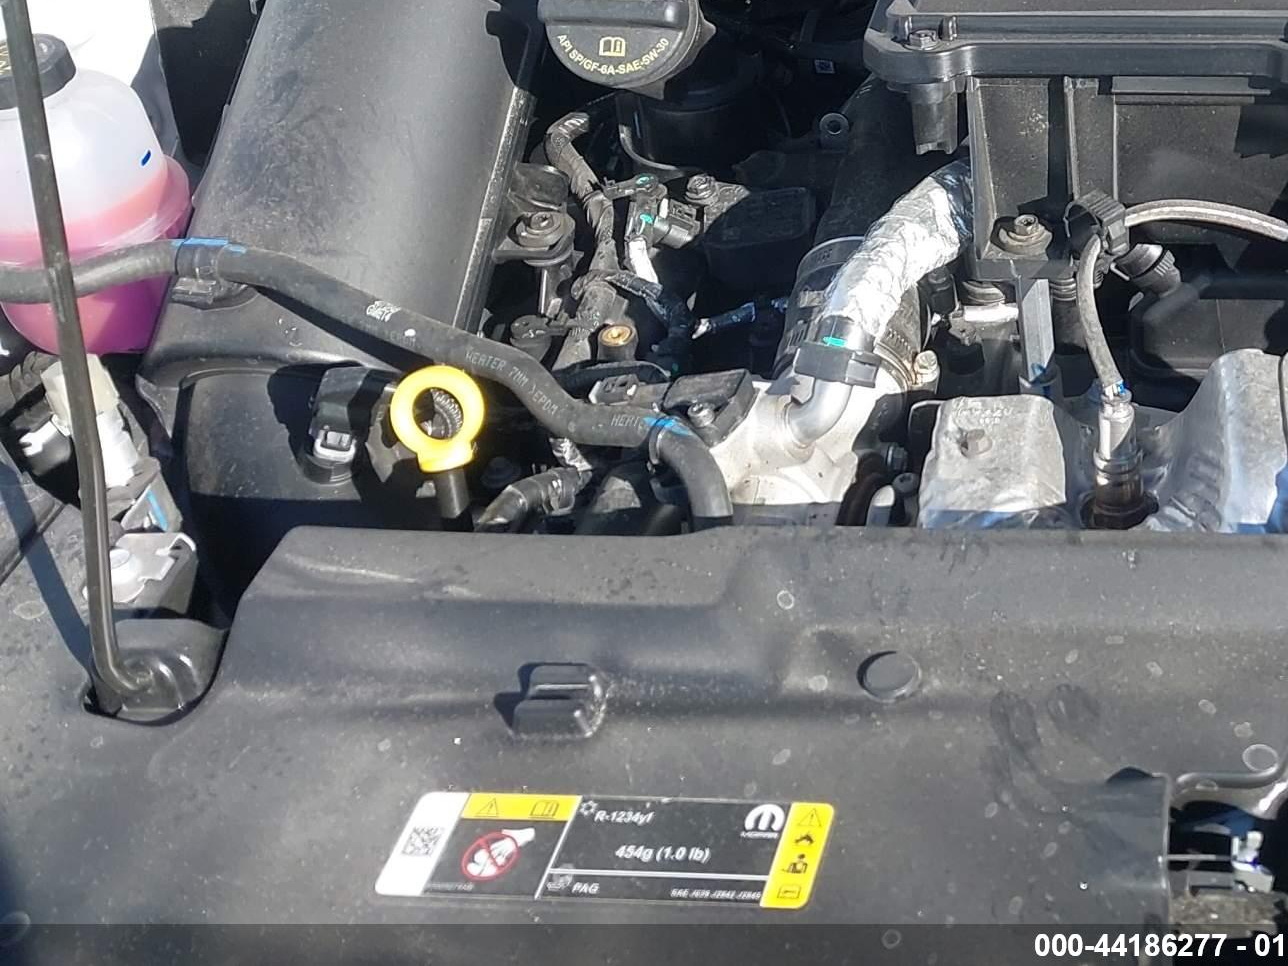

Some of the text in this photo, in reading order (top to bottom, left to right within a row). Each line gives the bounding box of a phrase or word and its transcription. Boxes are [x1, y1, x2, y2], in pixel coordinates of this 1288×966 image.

[556, 33, 573, 53] API
[465, 348, 507, 371] HEATER
[594, 810, 656, 826] R-1234yf
[614, 845, 711, 864] 454g (1.0 lb)
[571, 881, 601, 895] PAG
